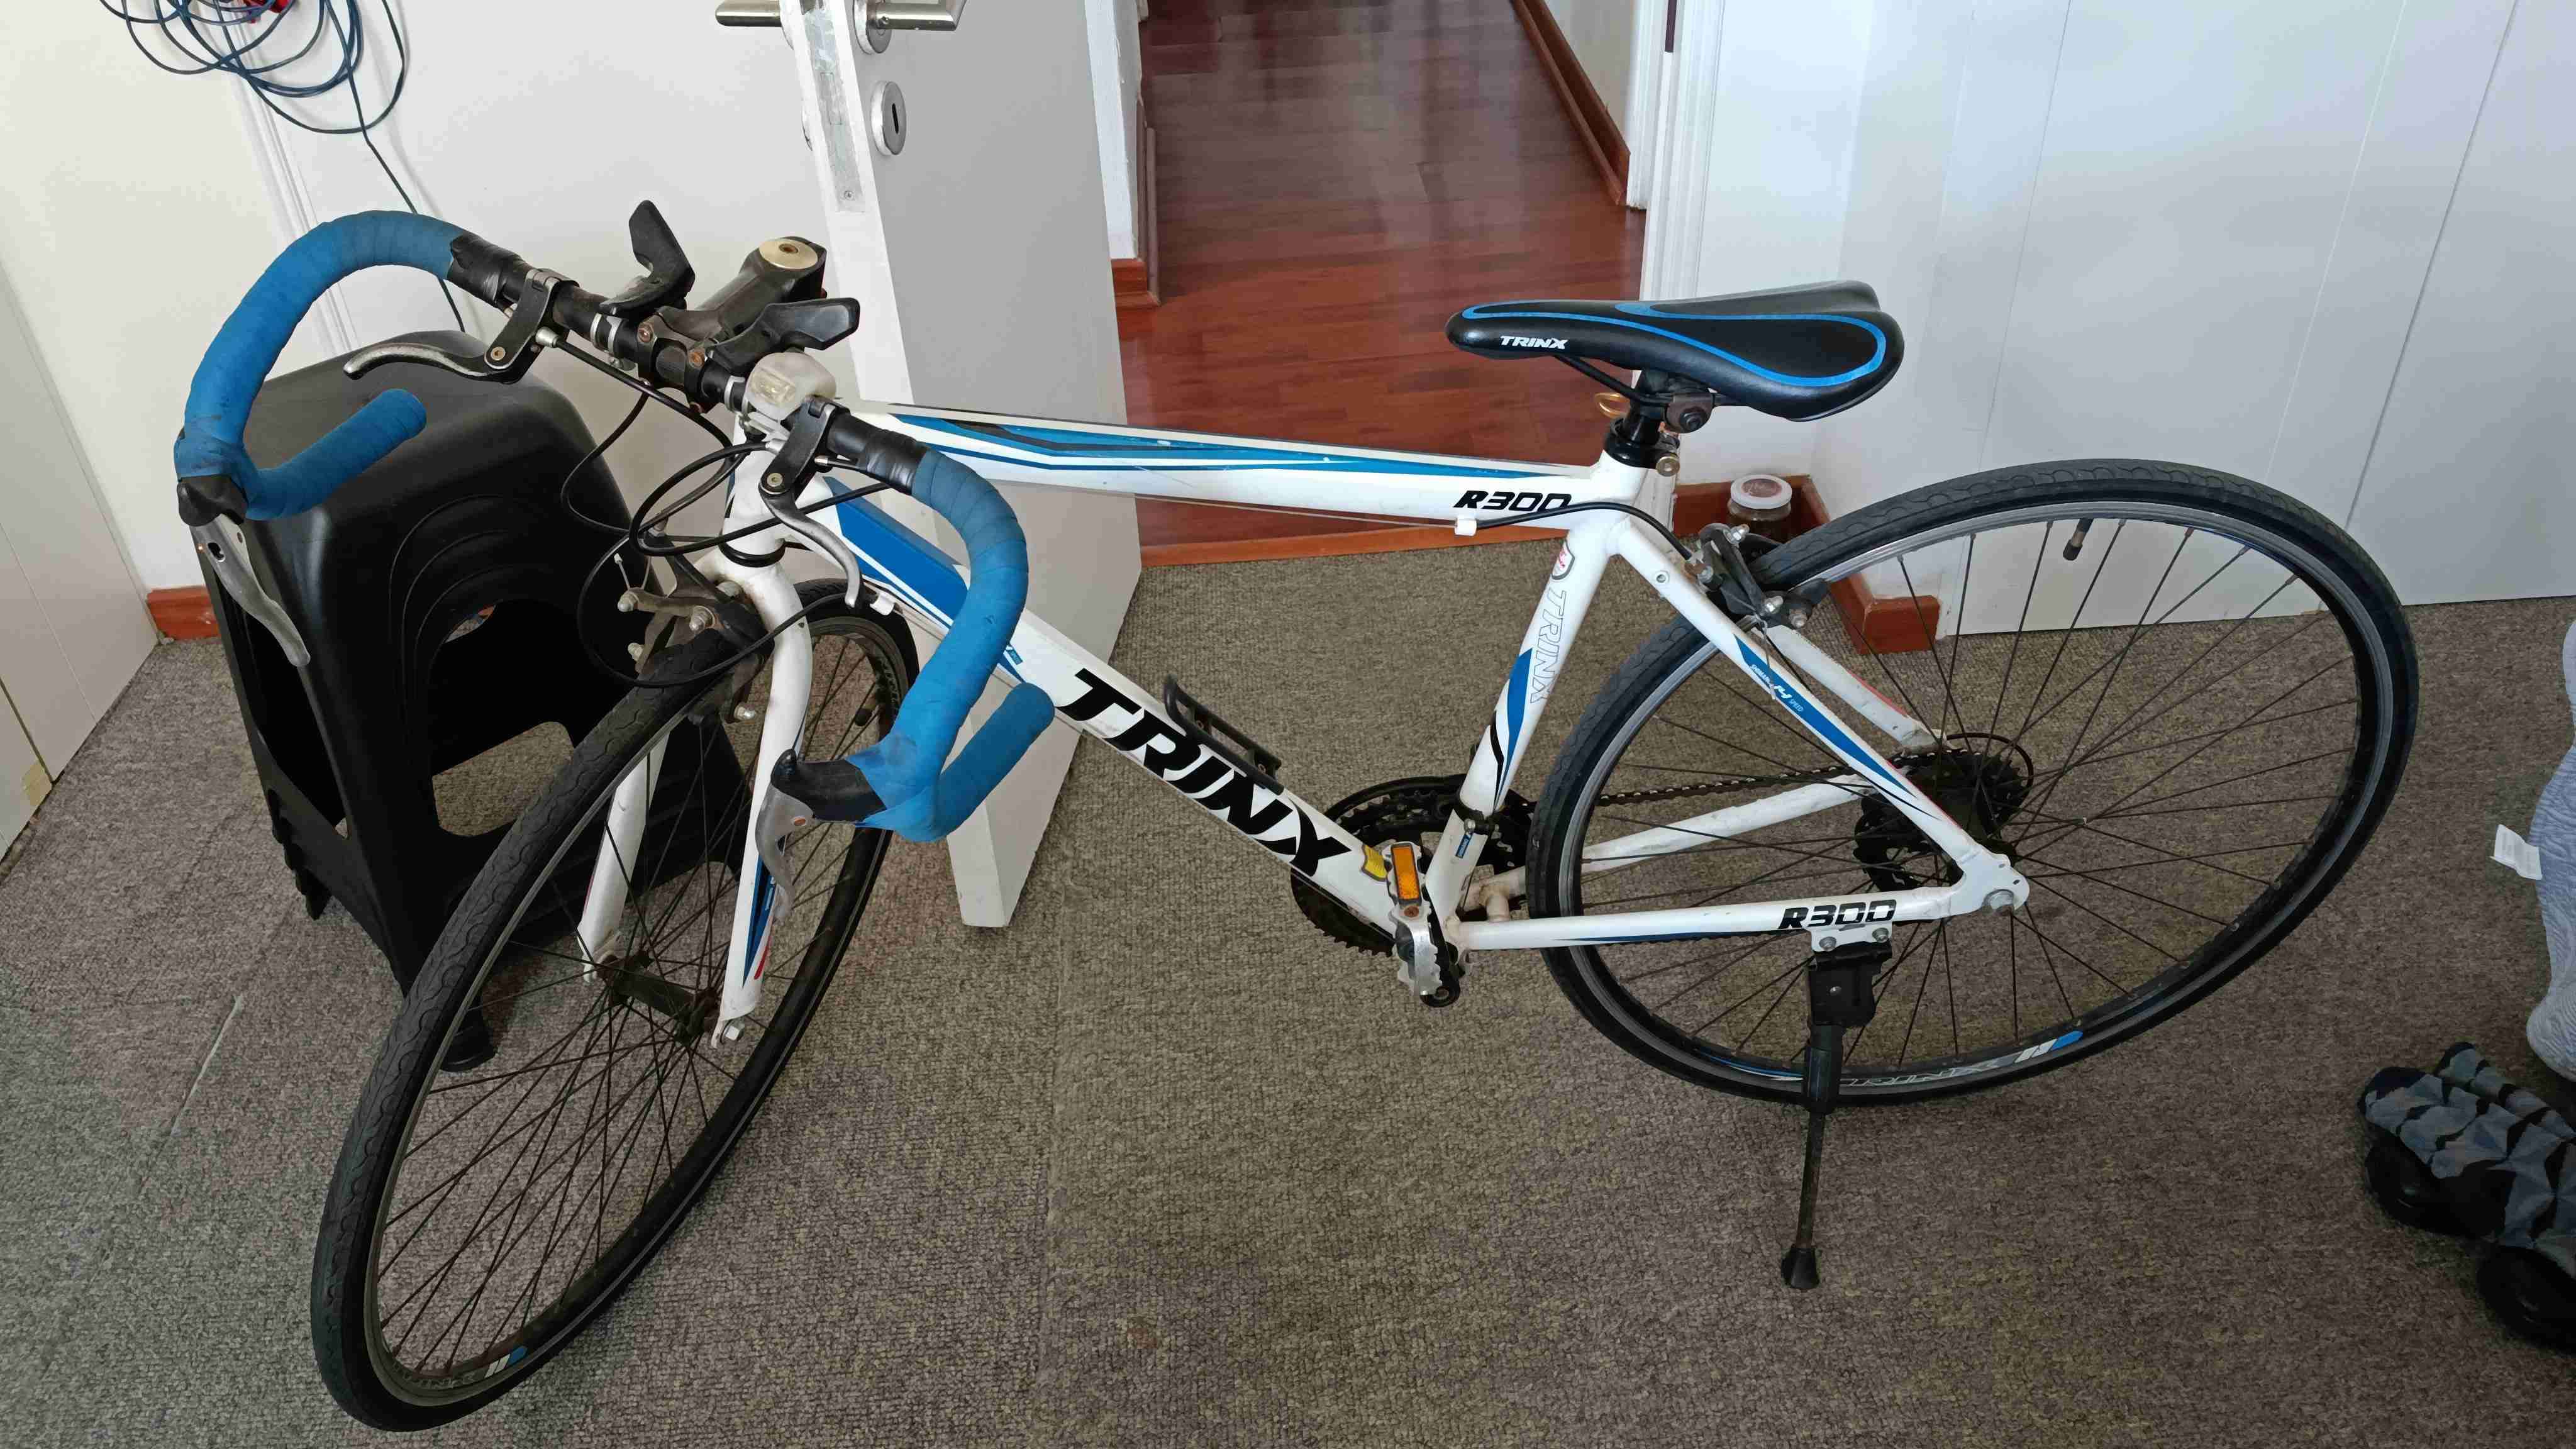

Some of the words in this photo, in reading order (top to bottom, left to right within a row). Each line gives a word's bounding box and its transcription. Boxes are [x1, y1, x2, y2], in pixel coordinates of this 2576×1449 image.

[1500, 335, 1568, 349] TRINX
[1453, 490, 1572, 513] R300
[1530, 587, 1567, 704] TRINX
[1054, 667, 1352, 877] TRINX
[1778, 899, 1897, 929] R300
